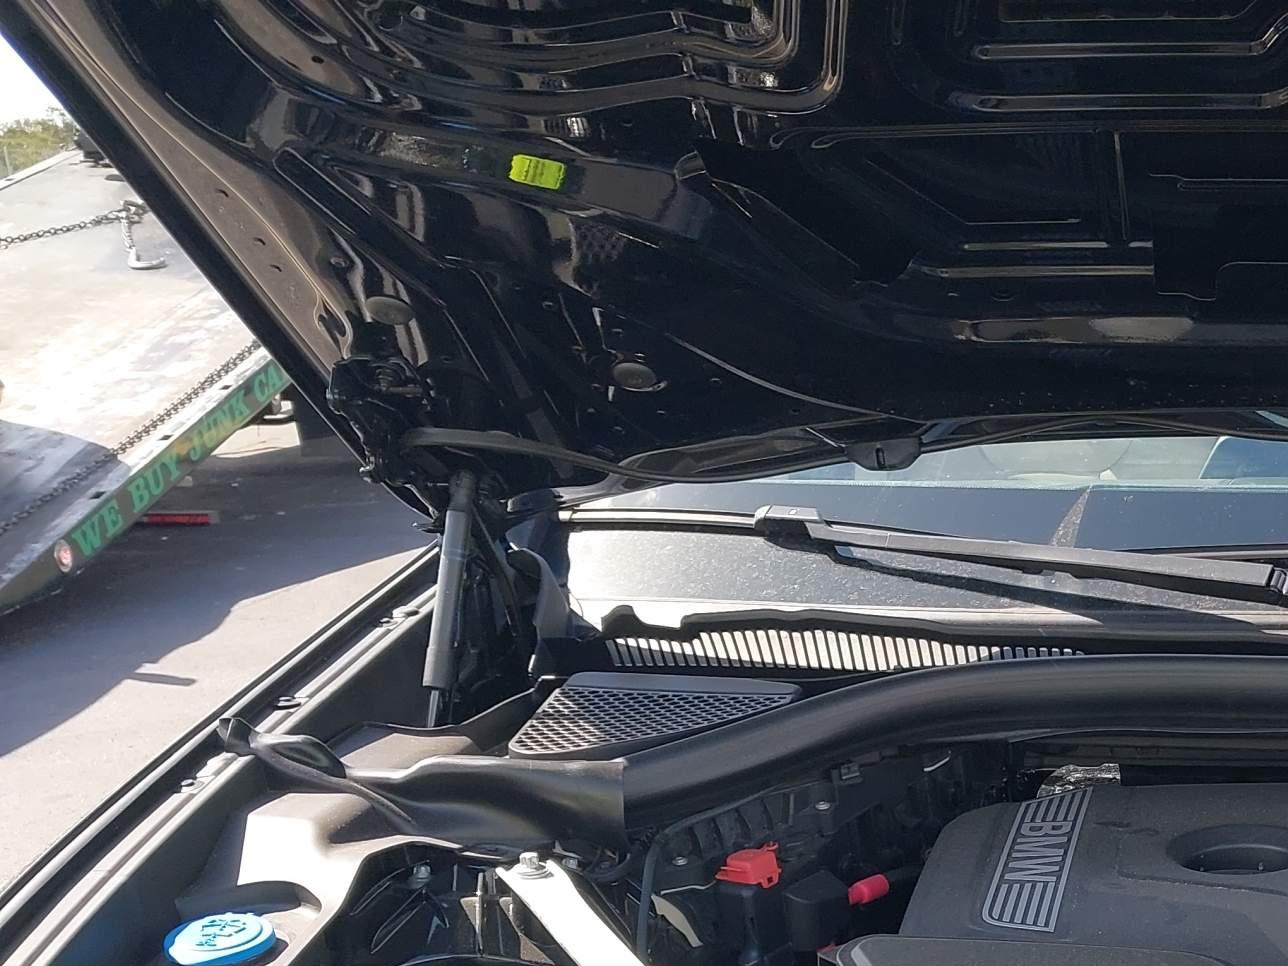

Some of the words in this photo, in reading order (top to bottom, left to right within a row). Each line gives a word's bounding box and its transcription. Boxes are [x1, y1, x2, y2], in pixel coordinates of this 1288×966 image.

[72, 499, 122, 558] WE
[129, 455, 182, 513] BUY
[188, 390, 250, 461] JUNK
[1004, 820, 1073, 882] BMW
